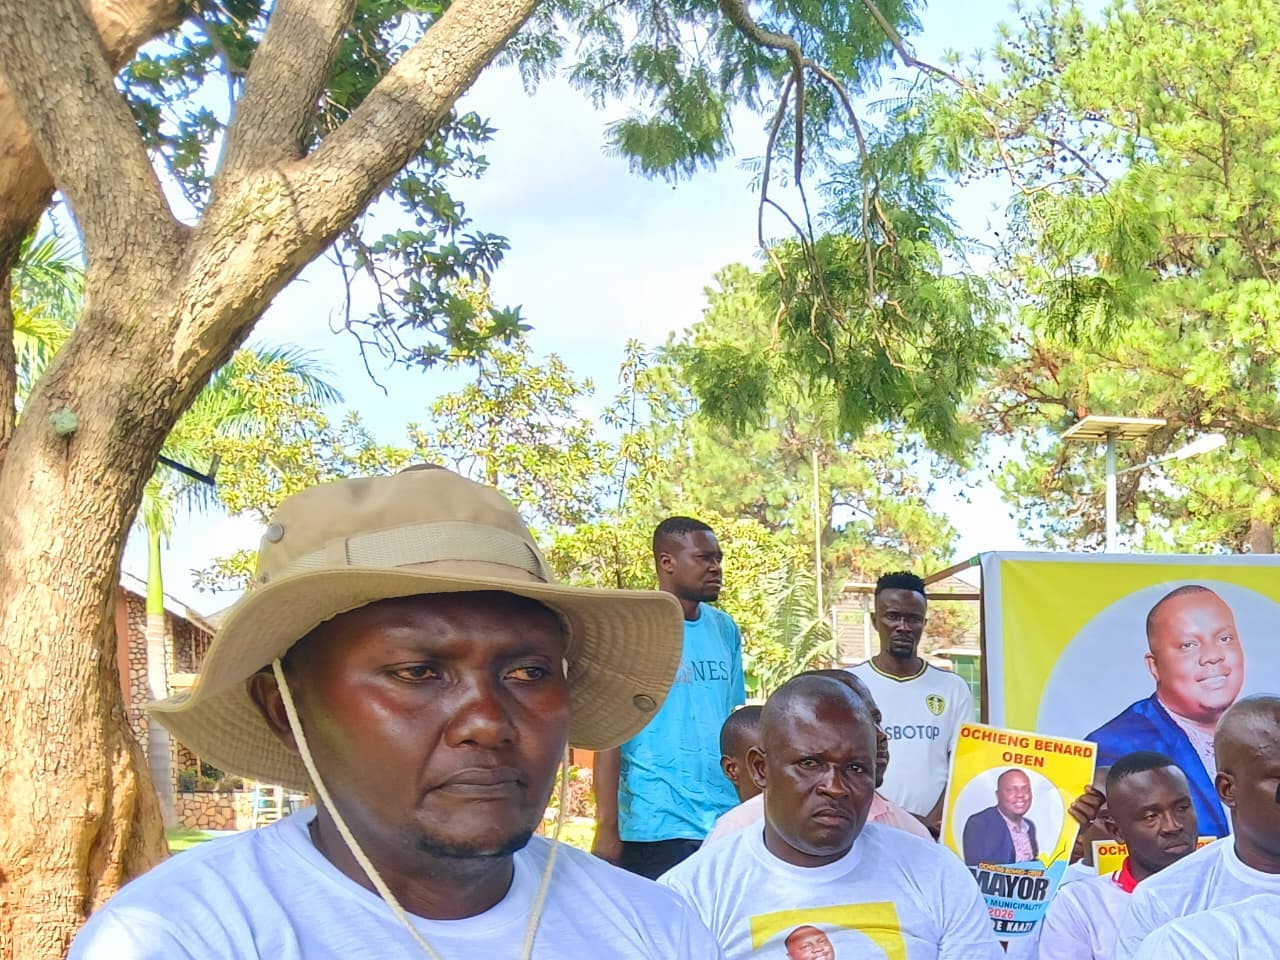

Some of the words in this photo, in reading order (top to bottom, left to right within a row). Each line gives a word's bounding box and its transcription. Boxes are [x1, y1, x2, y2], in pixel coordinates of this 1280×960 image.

[885, 725, 940, 740] SBOTOP
[960, 727, 1030, 748] OCHIENG
[1034, 740, 1093, 758] BENARD
[1002, 751, 1044, 768] OBEN
[968, 868, 1049, 901] MAYOR
[988, 907, 1014, 919] 2026
